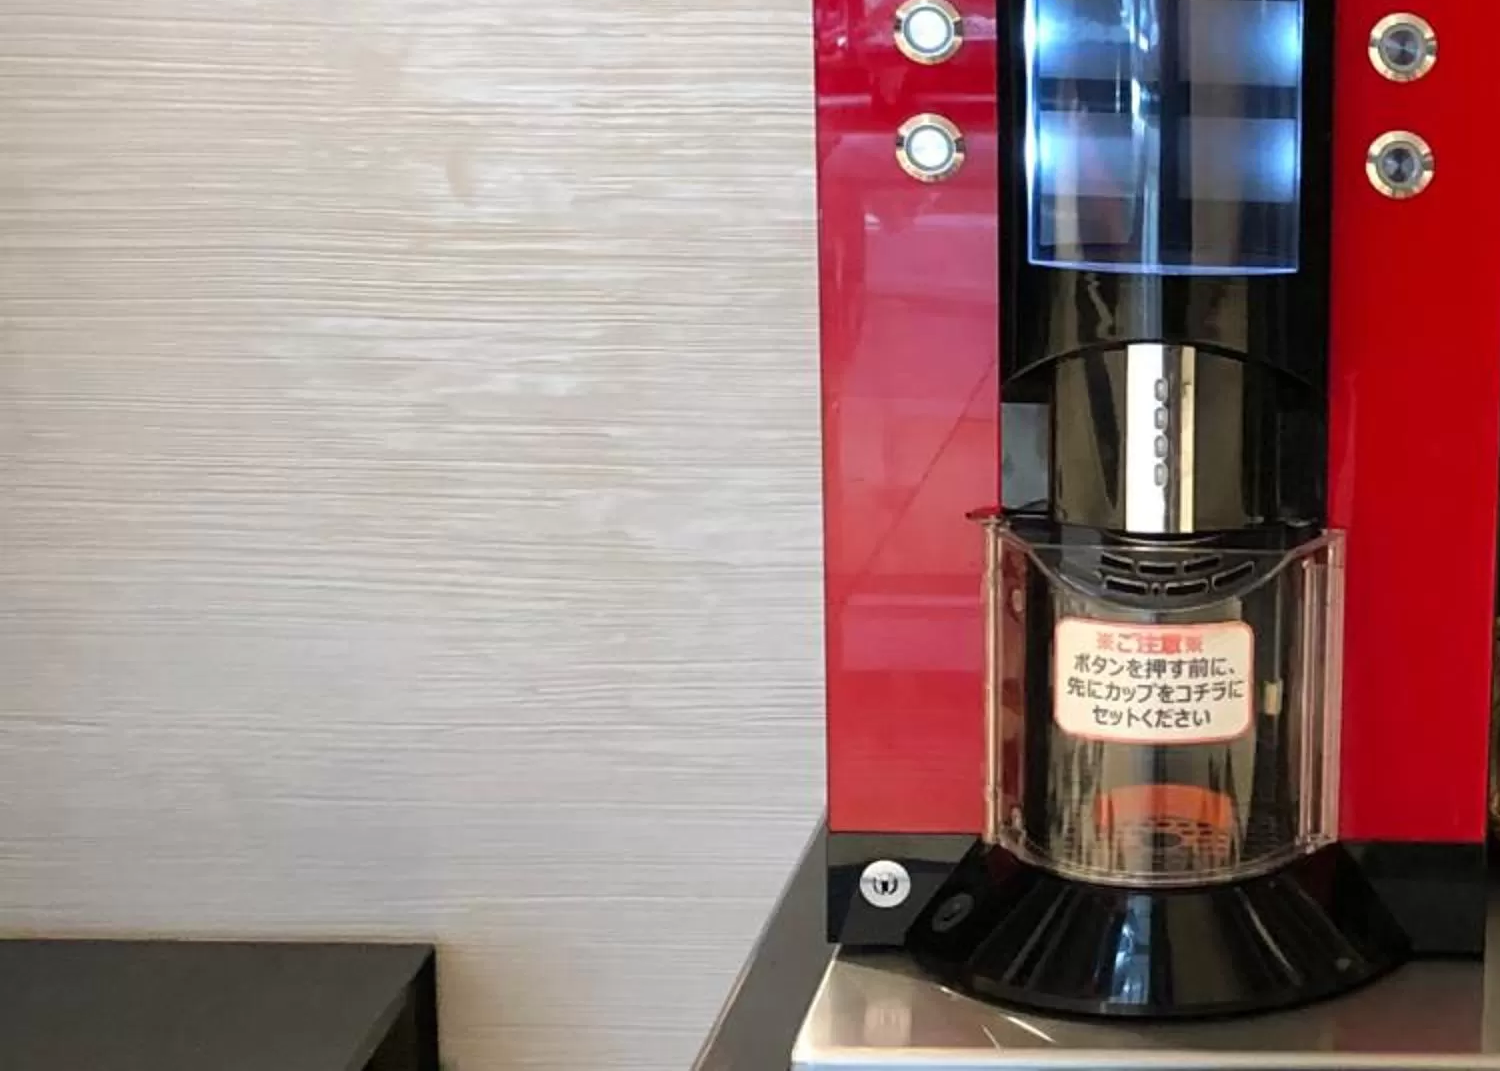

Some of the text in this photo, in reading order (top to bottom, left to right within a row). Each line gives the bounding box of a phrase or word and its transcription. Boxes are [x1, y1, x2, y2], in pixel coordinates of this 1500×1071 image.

[1073, 654, 1235, 680] ボタンを押す前に、
[1066, 676, 1245, 704] 先にカップをコチラに
[1092, 705, 1212, 729] セットください
